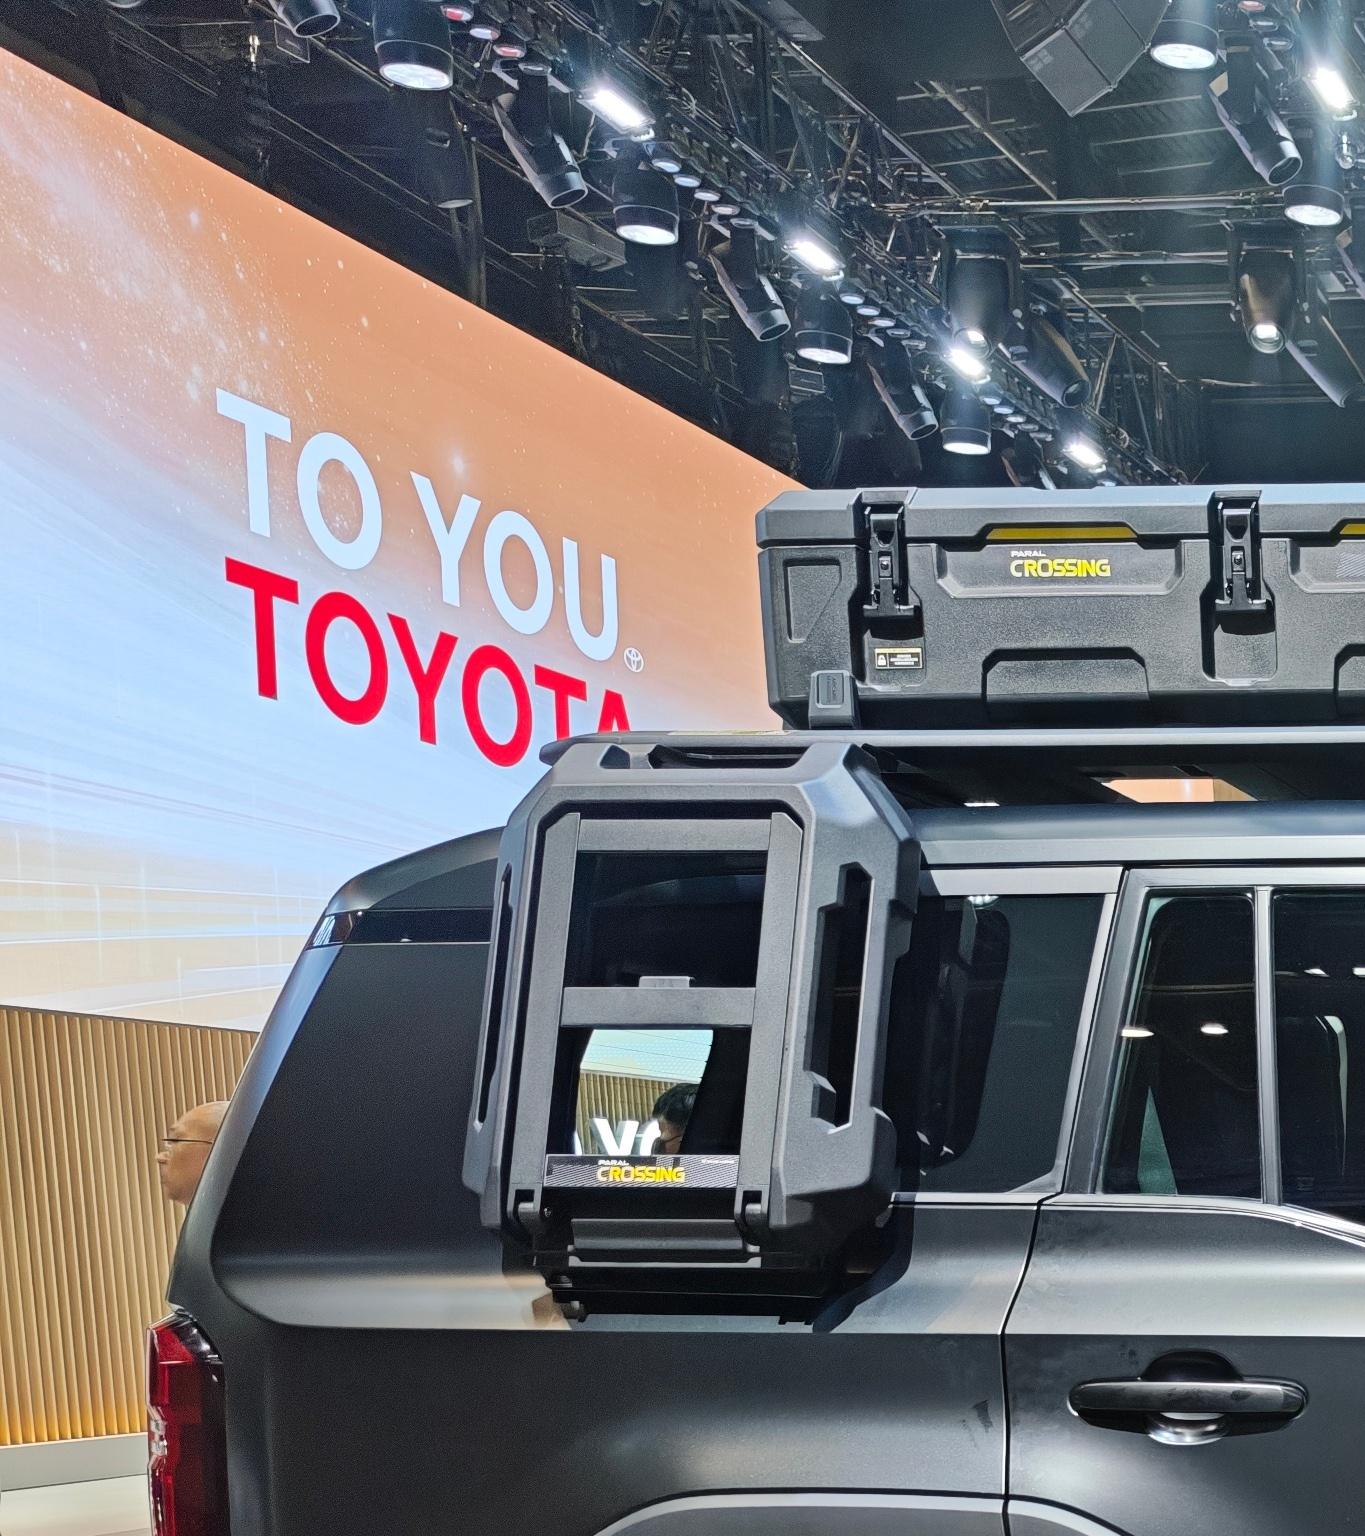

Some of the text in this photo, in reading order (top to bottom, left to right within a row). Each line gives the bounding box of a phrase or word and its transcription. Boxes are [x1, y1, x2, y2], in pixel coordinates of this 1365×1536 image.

[216, 388, 619, 661] TO YOU
[1010, 559, 1111, 578] CROSSING
[597, 1166, 687, 1183] CROSSING
